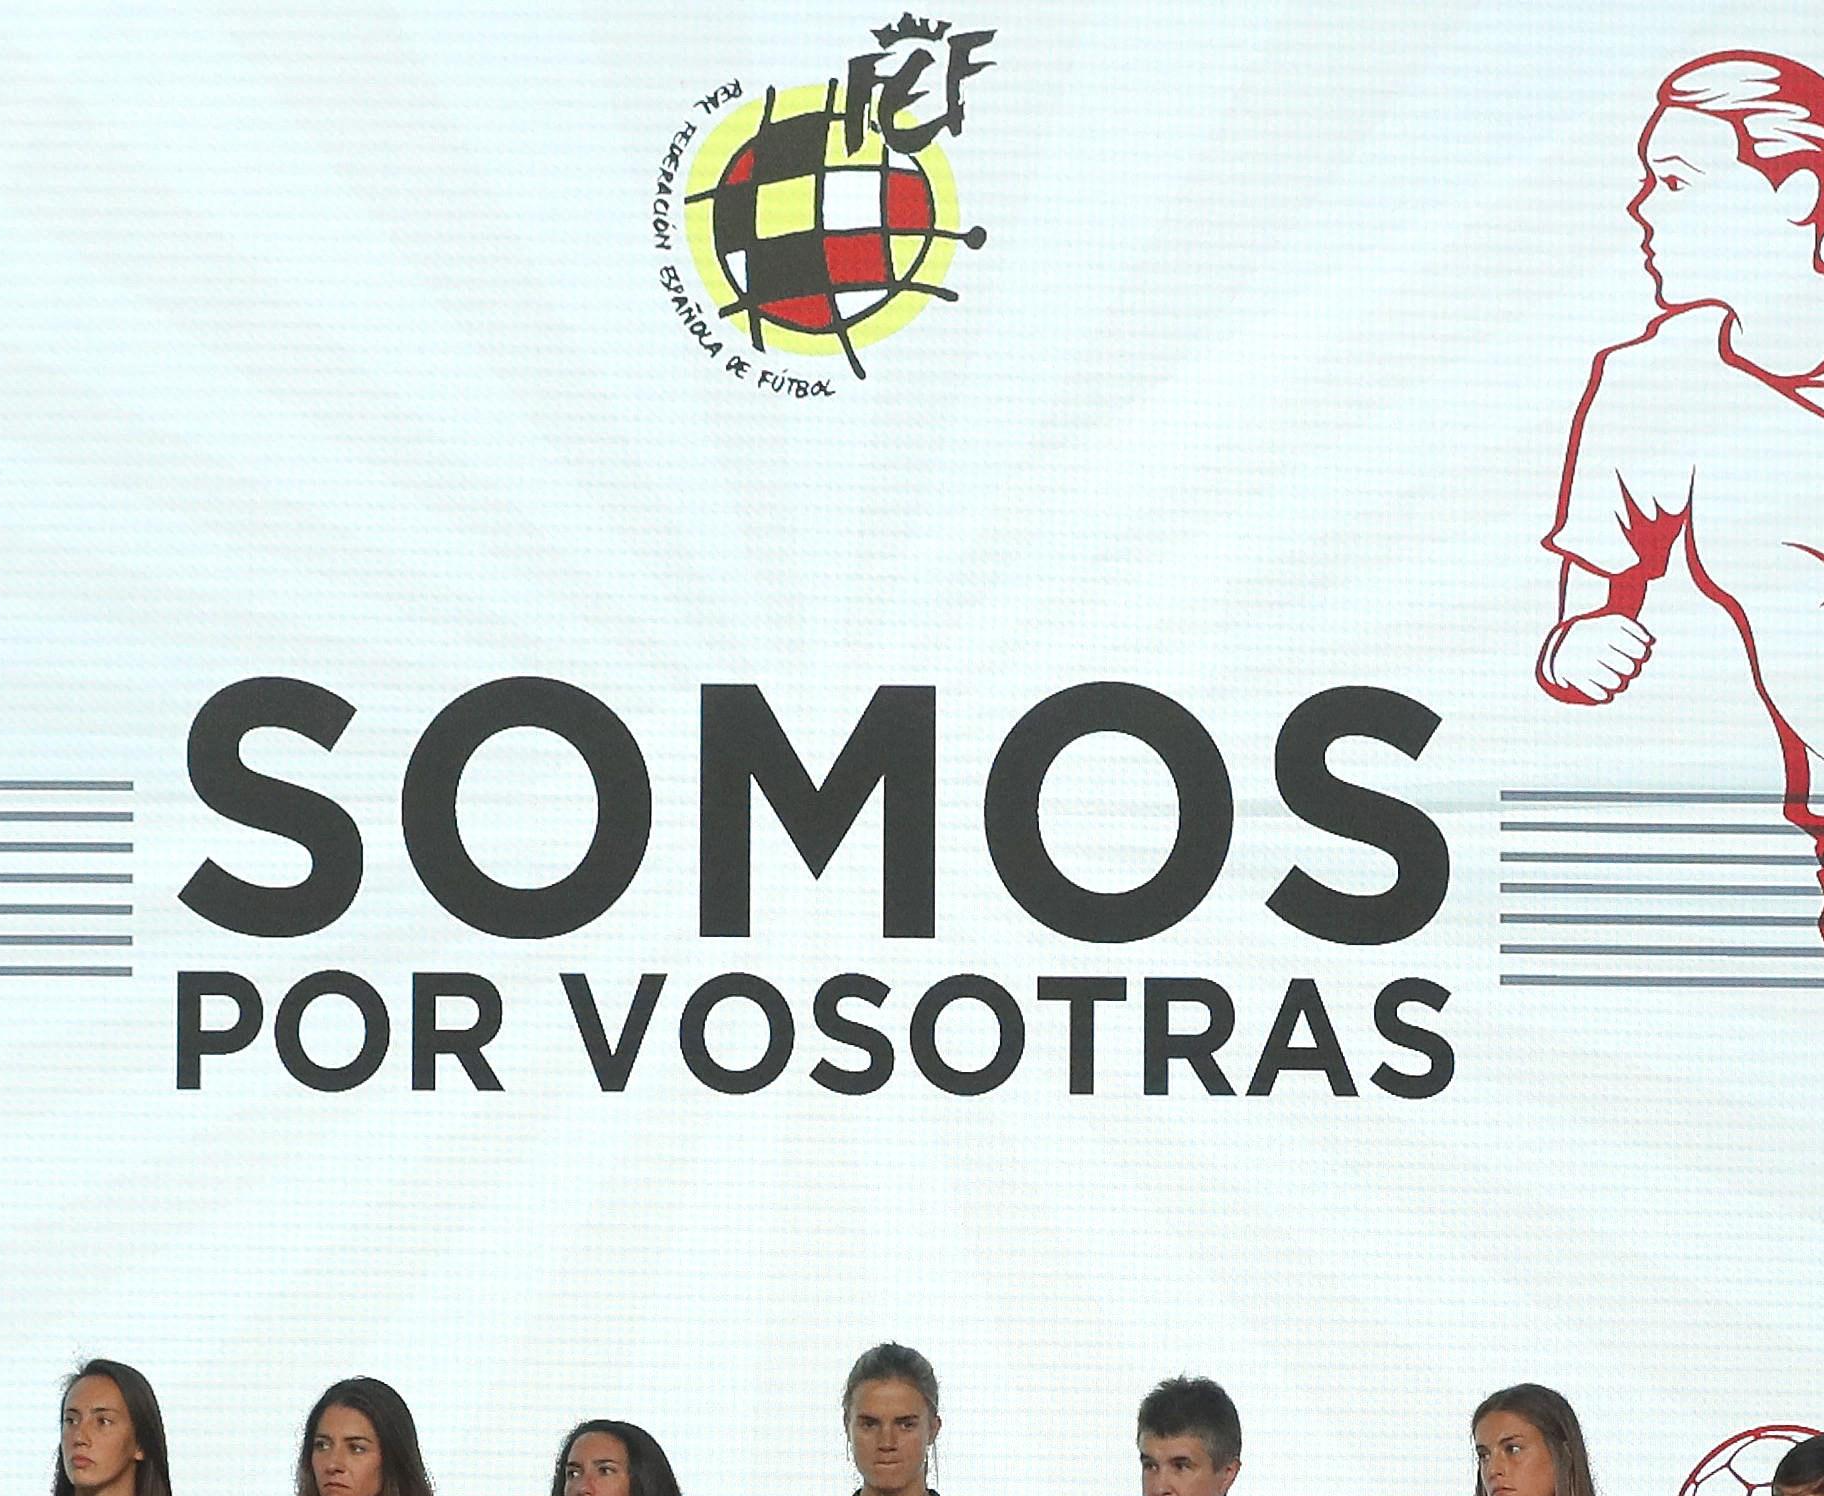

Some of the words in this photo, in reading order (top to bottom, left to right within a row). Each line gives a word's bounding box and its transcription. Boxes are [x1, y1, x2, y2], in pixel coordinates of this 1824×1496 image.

[694, 79, 743, 115] REAL
[653, 121, 698, 250] FEDERACIÓN
[660, 265, 724, 358] ESPAÑOLA
[726, 355, 751, 379] DE
[758, 370, 836, 399] FÚTBOL
[178, 676, 1450, 945] SOMOS
[177, 970, 504, 1093] POR
[560, 971, 1456, 1100] VOSOTRAS
